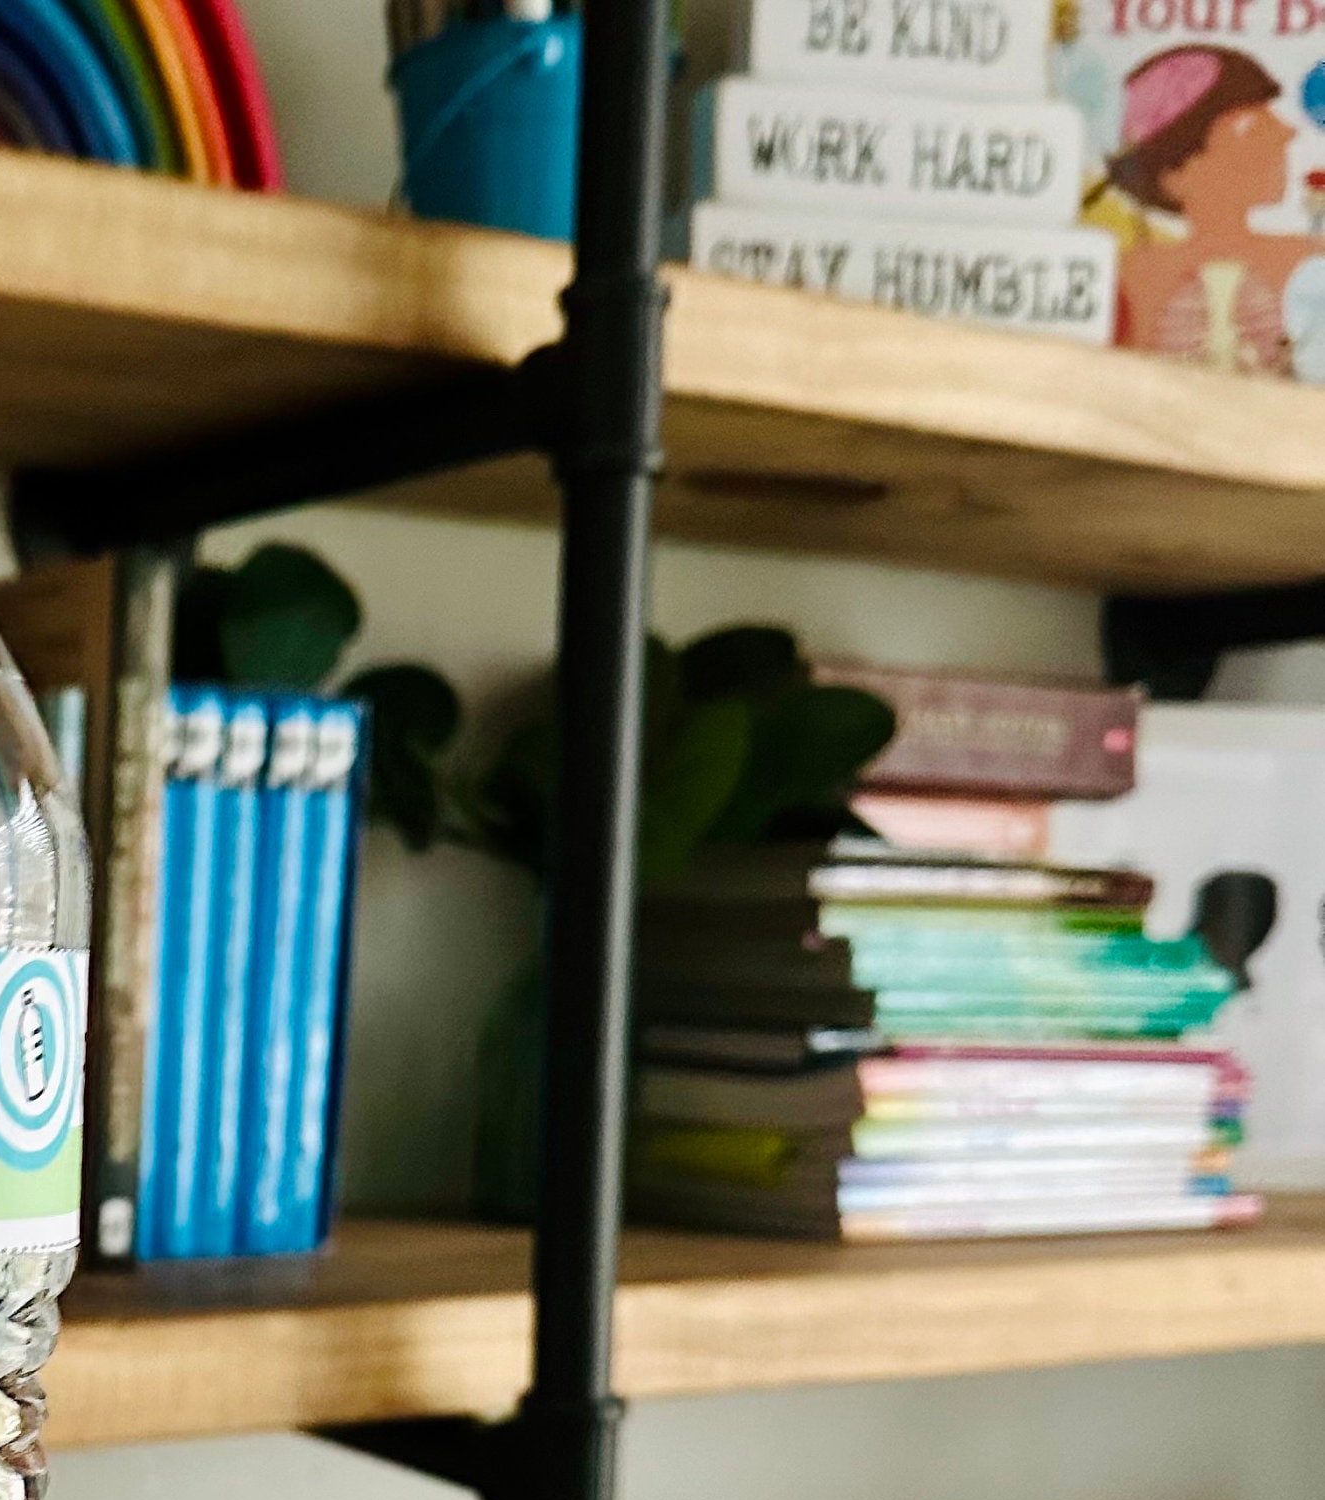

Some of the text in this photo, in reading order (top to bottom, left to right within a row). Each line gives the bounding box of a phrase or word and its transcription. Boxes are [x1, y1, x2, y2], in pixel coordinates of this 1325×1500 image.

[805, 0, 1011, 66] BE KIND
[746, 112, 1058, 198] WORK HARD
[873, 242, 1097, 325] HUMBLE
